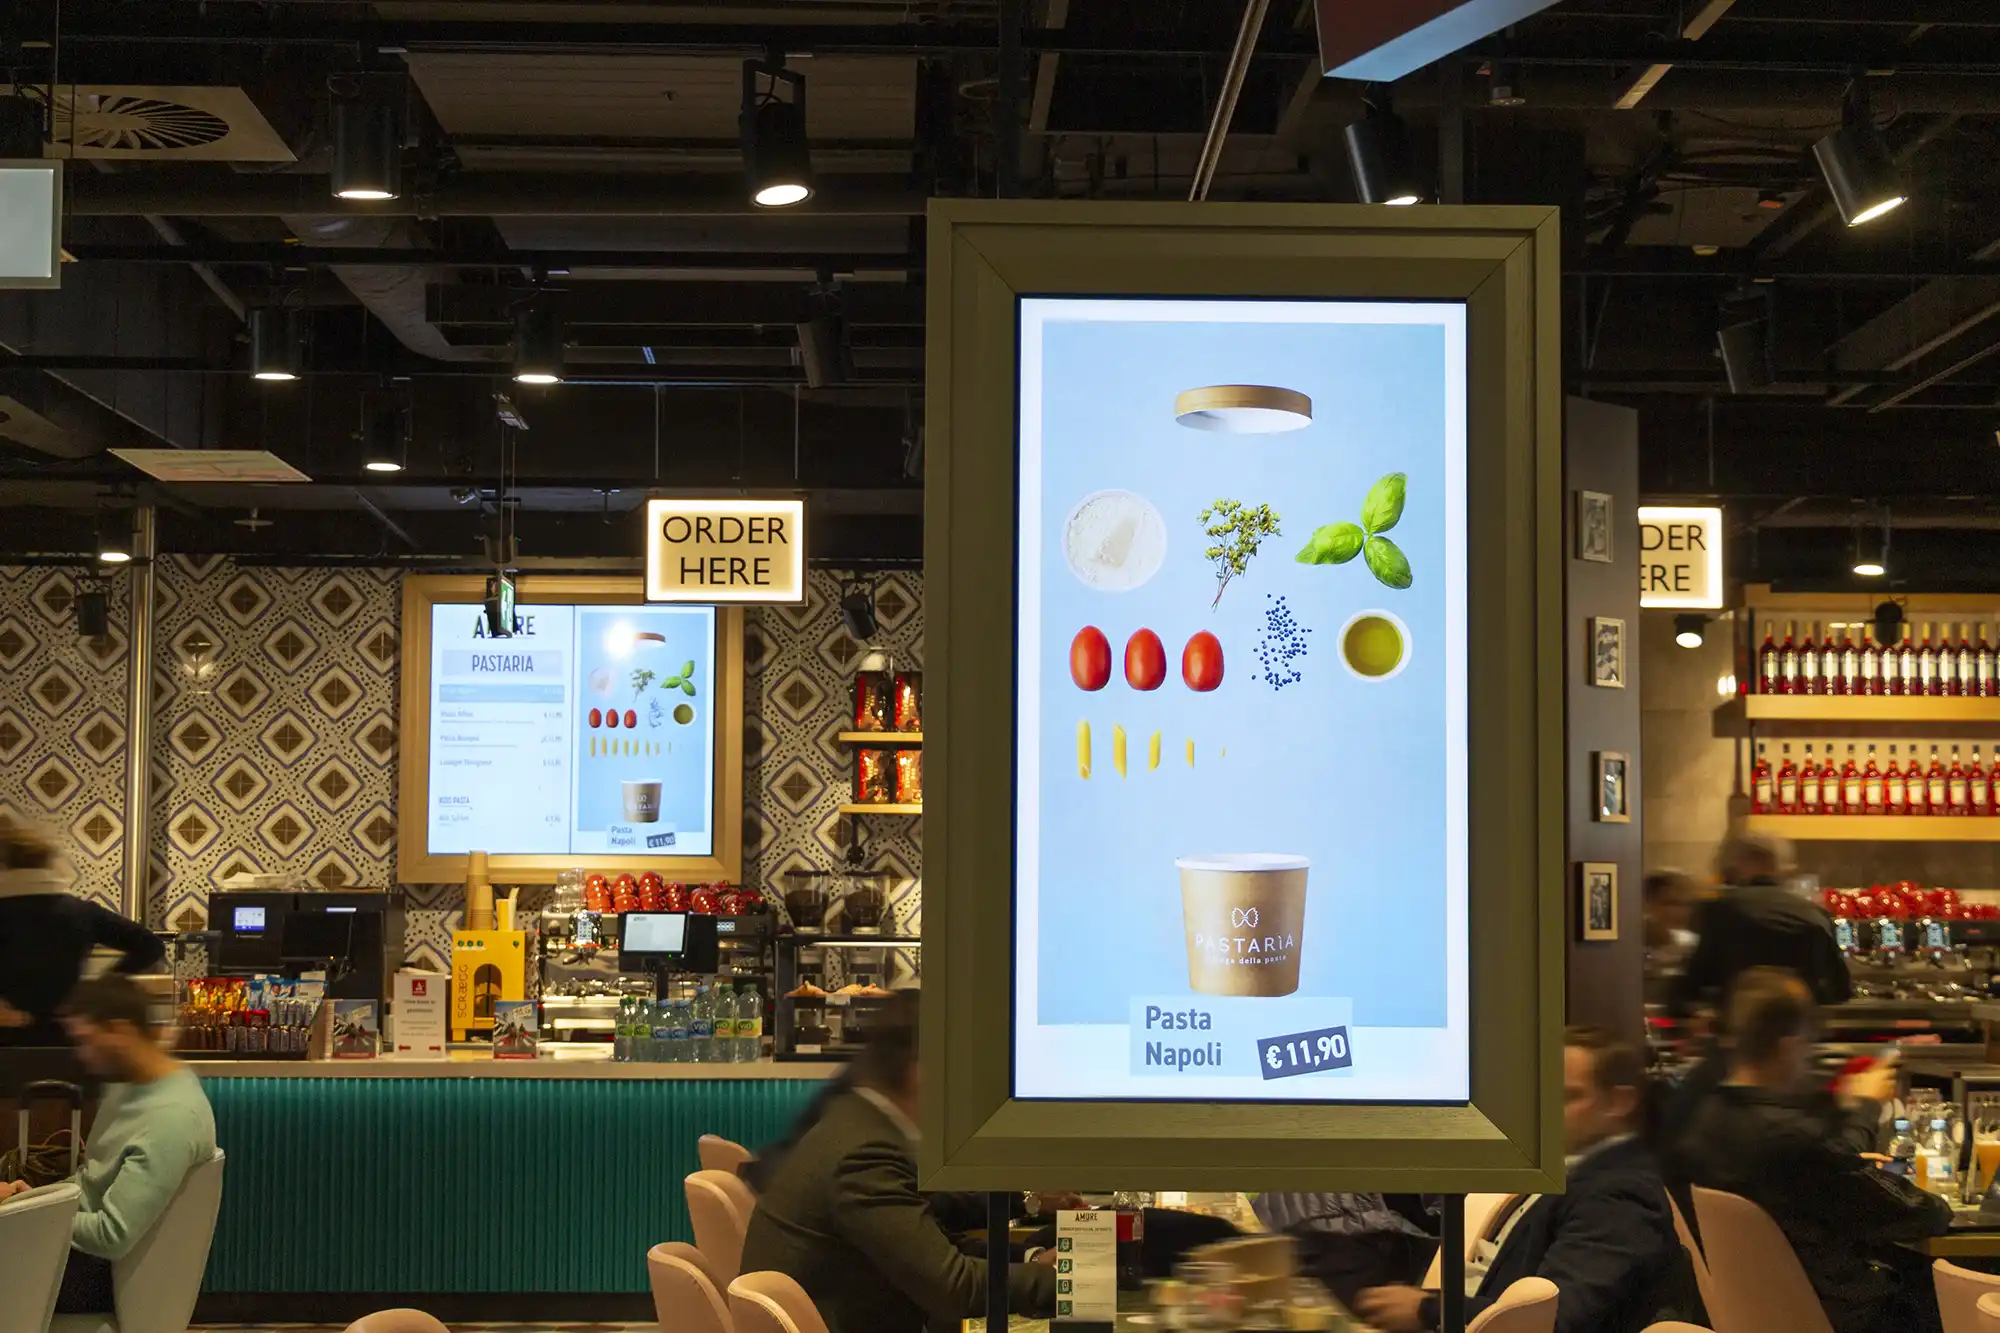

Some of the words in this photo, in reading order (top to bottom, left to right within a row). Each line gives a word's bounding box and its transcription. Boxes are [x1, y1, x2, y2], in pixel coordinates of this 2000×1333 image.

[663, 516, 788, 544] ORDER
[1640, 525, 1706, 550] DER
[681, 557, 770, 585] HERE
[472, 615, 536, 639] ARE
[472, 655, 534, 672] PASTARIA
[611, 836, 635, 846] Napoli
[1146, 1006, 1211, 1030] Pasta
[1146, 1041, 1222, 1072] Napoli
